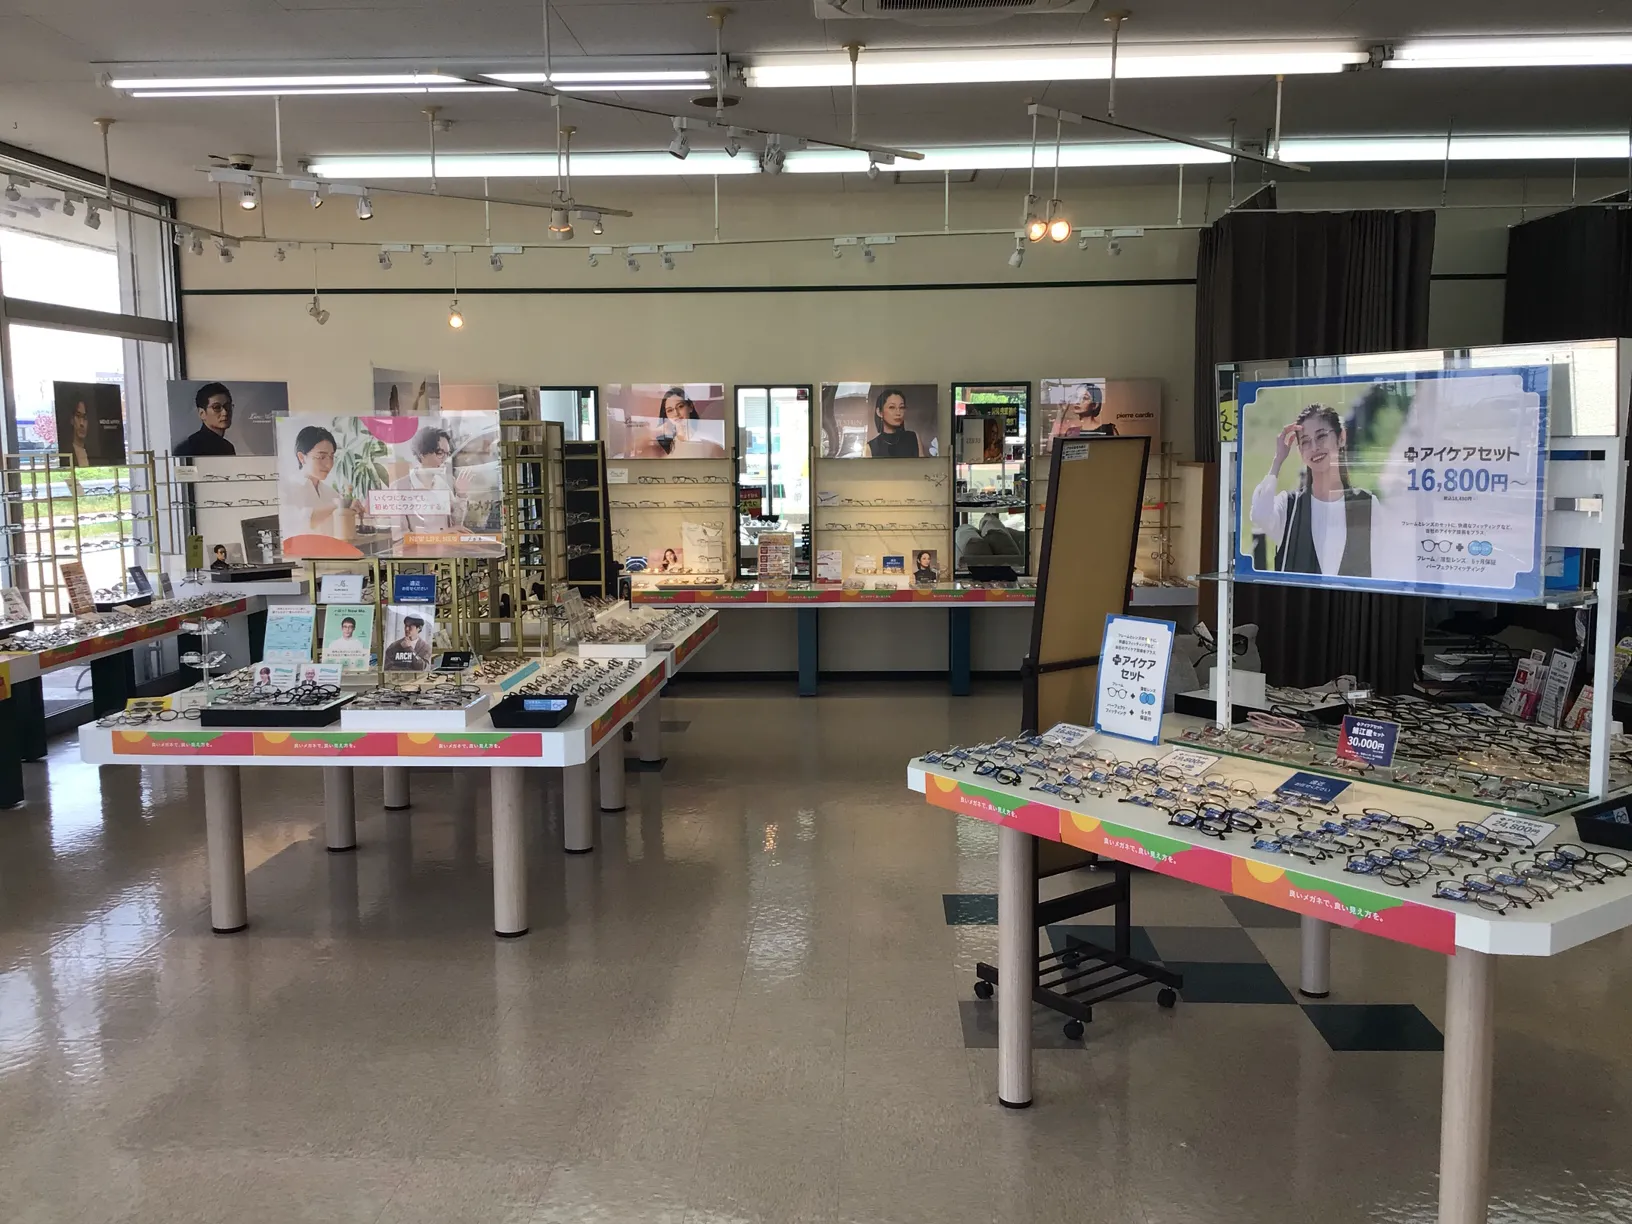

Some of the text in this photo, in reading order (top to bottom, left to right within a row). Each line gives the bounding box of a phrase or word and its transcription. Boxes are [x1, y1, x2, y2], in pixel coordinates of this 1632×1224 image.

[1420, 446, 1520, 462] アイケアセット
[395, 652, 413, 660] ARCH
[1122, 656, 1156, 670] アイケア
[1121, 669, 1145, 681] セット
[1347, 736, 1384, 750] 30,000円
[1103, 837, 1177, 865] 良いメガネで、良い見え方を。
[1289, 889, 1384, 923] 良いメガネで、良い見え方を。
